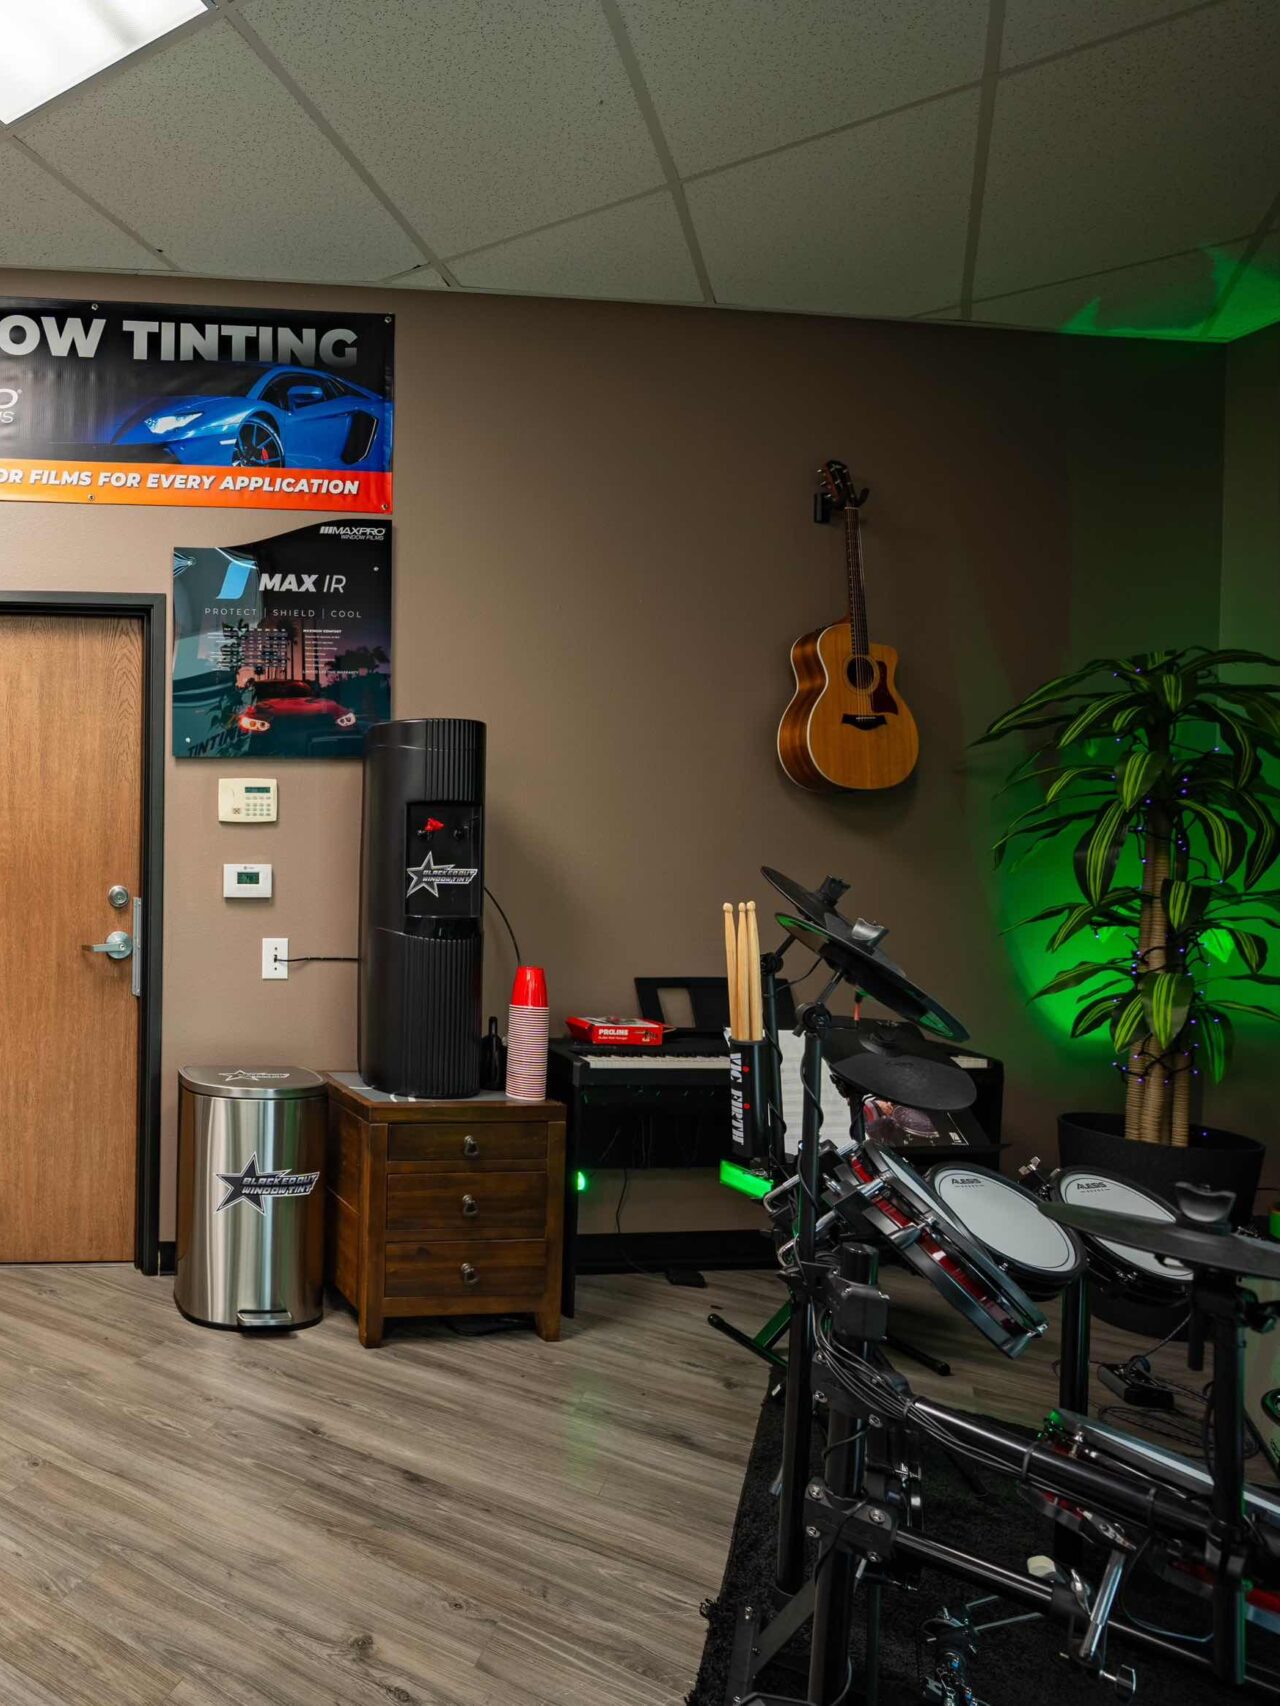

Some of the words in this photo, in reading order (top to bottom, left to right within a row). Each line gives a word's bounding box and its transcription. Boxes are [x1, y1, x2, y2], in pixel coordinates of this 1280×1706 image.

[122, 319, 359, 368] TINTING
[29, 470, 92, 486] FILMS
[98, 472, 141, 488] FOR
[146, 473, 216, 490] EVERY
[220, 475, 360, 495] APPLICATION
[258, 572, 319, 593] MAX
[323, 574, 347, 593] IR
[204, 607, 257, 616] PROTECT
[272, 608, 315, 617] SHIELD
[330, 609, 362, 618] COOL
[598, 1028, 629, 1036] PROLINE
